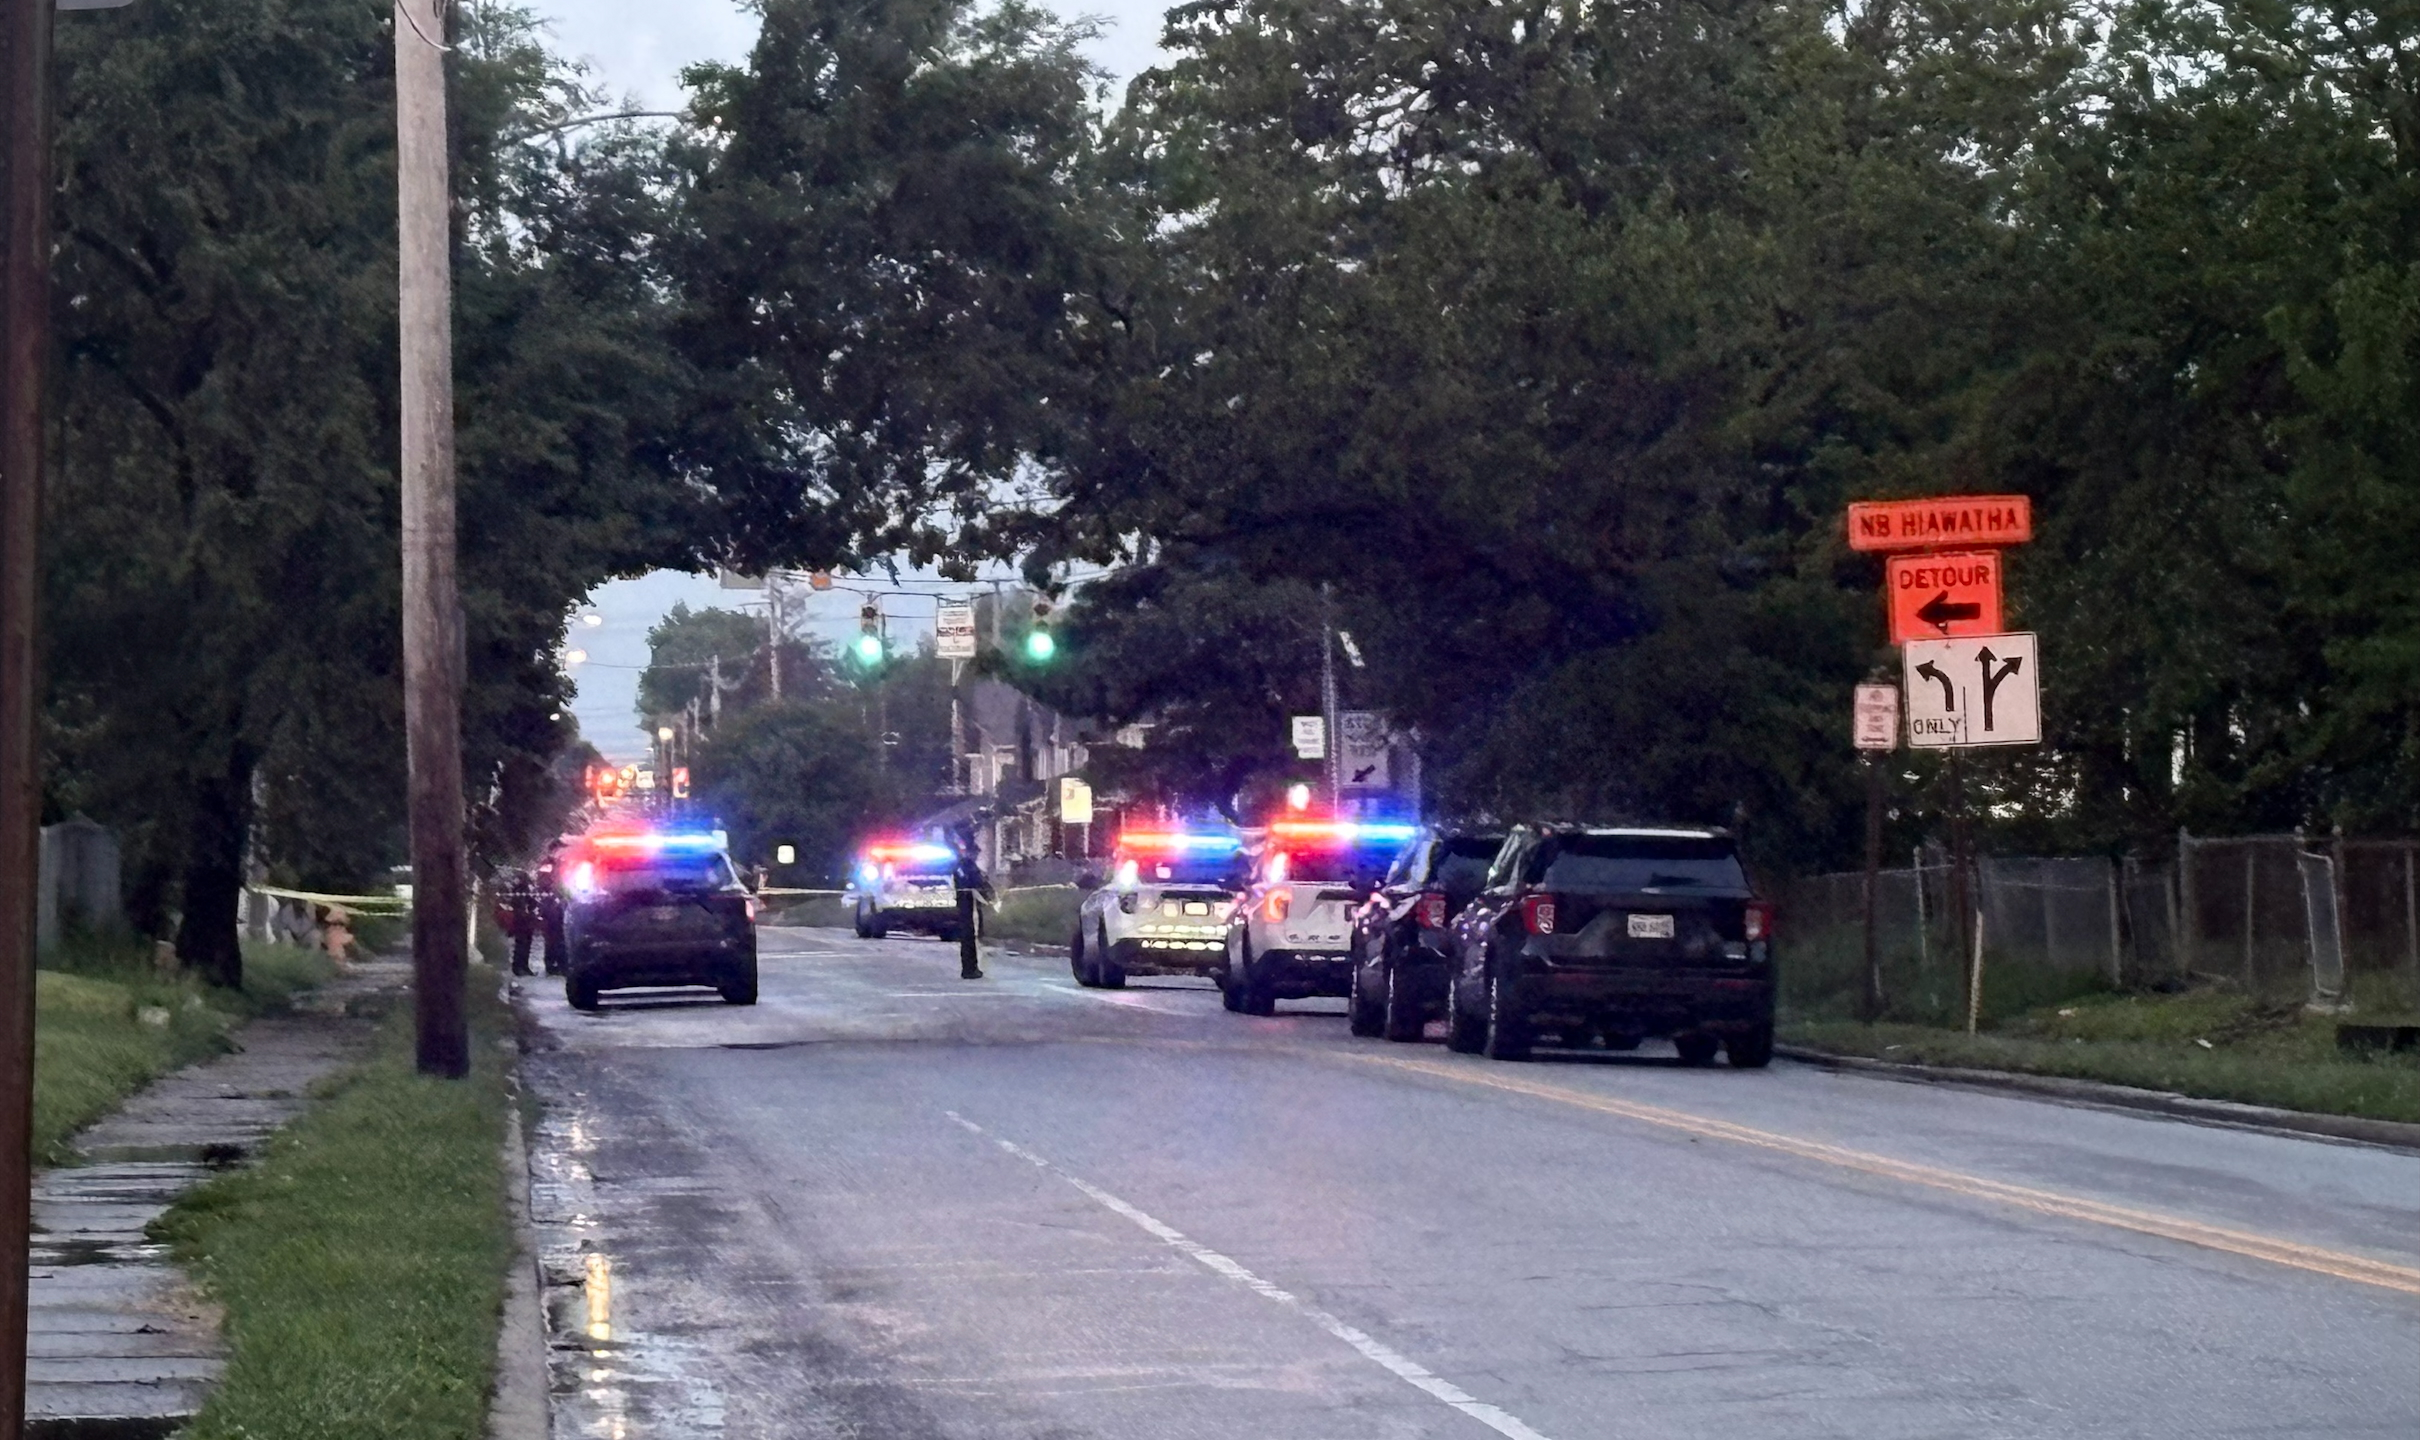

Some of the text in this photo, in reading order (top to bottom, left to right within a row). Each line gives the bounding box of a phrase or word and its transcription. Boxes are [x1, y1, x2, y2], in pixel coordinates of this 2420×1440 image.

[1860, 507, 2020, 537] NB HIAWATHA
[1899, 565, 1990, 590] DETOUR
[1913, 717, 1961, 735] ONLY
